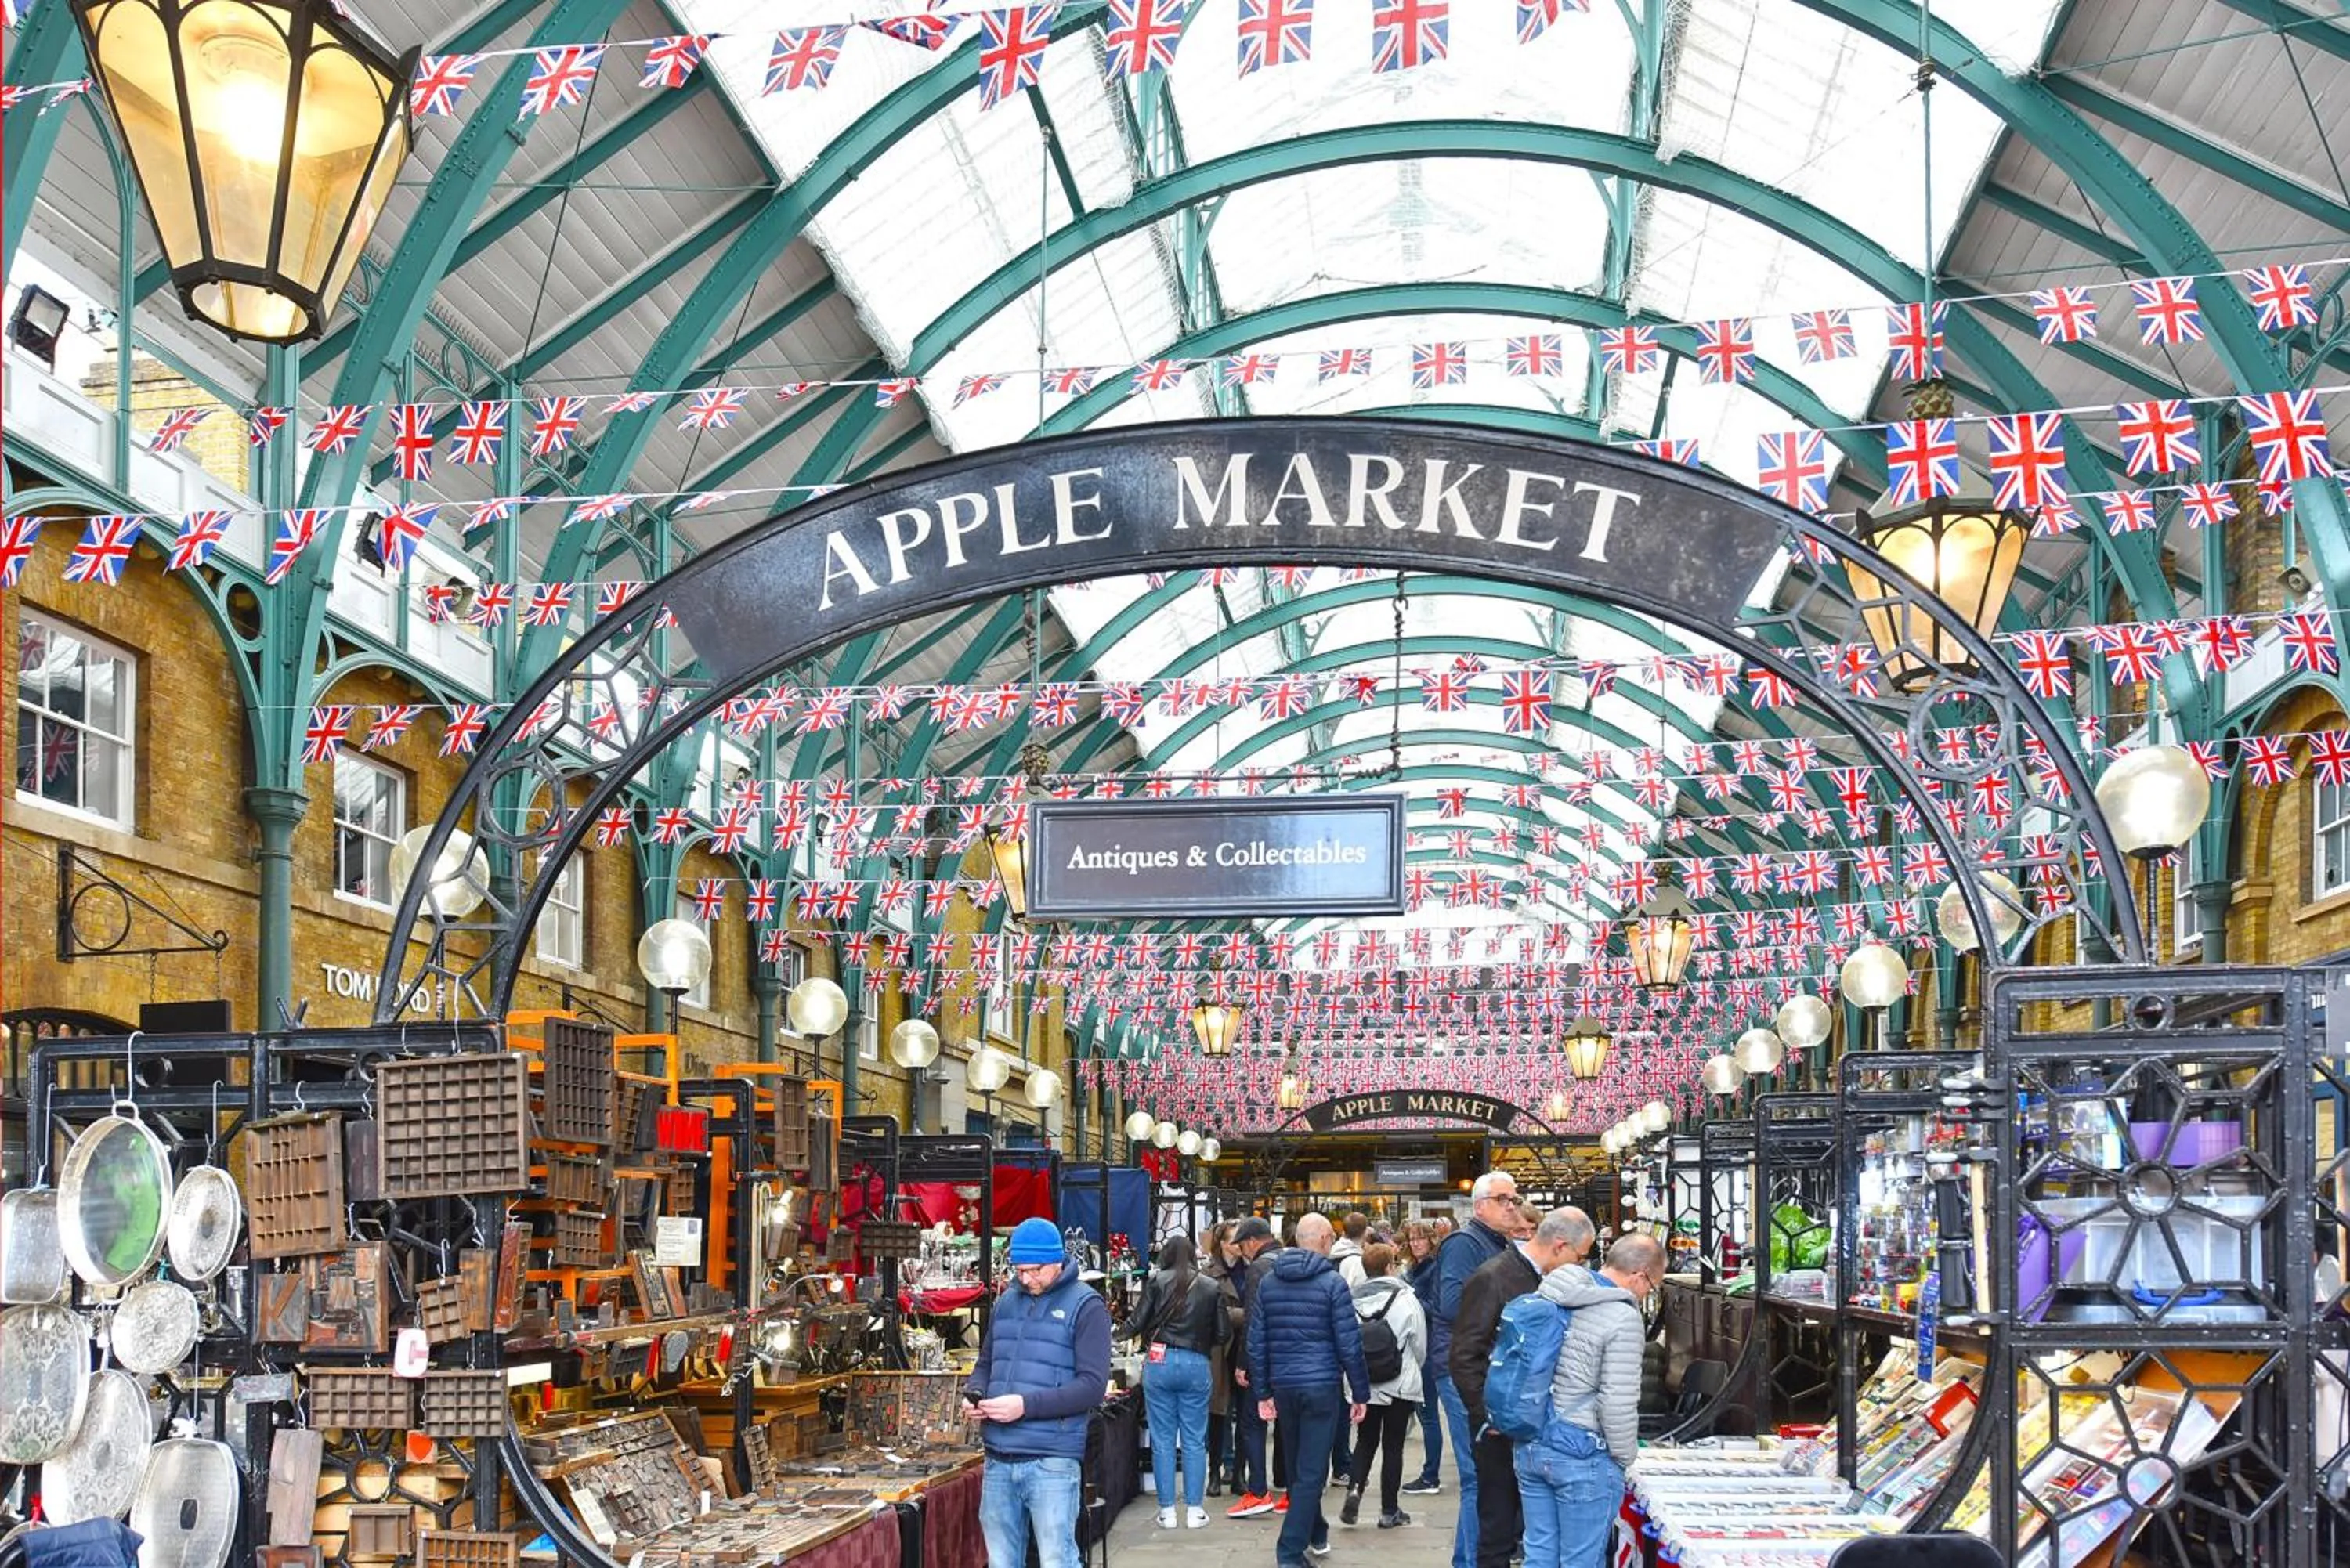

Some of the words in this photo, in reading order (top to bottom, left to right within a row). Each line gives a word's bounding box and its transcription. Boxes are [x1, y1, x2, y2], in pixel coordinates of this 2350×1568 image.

[818, 467, 1113, 612] APPLE
[1172, 452, 1642, 564] MARKET
[1067, 844, 1178, 875] Antiques
[1186, 845, 1207, 867] &
[1215, 838, 1368, 867] Collectables
[321, 963, 371, 1002] TOM
[1332, 1096, 1393, 1122] APPLE
[1408, 1095, 1499, 1120] MARKET
